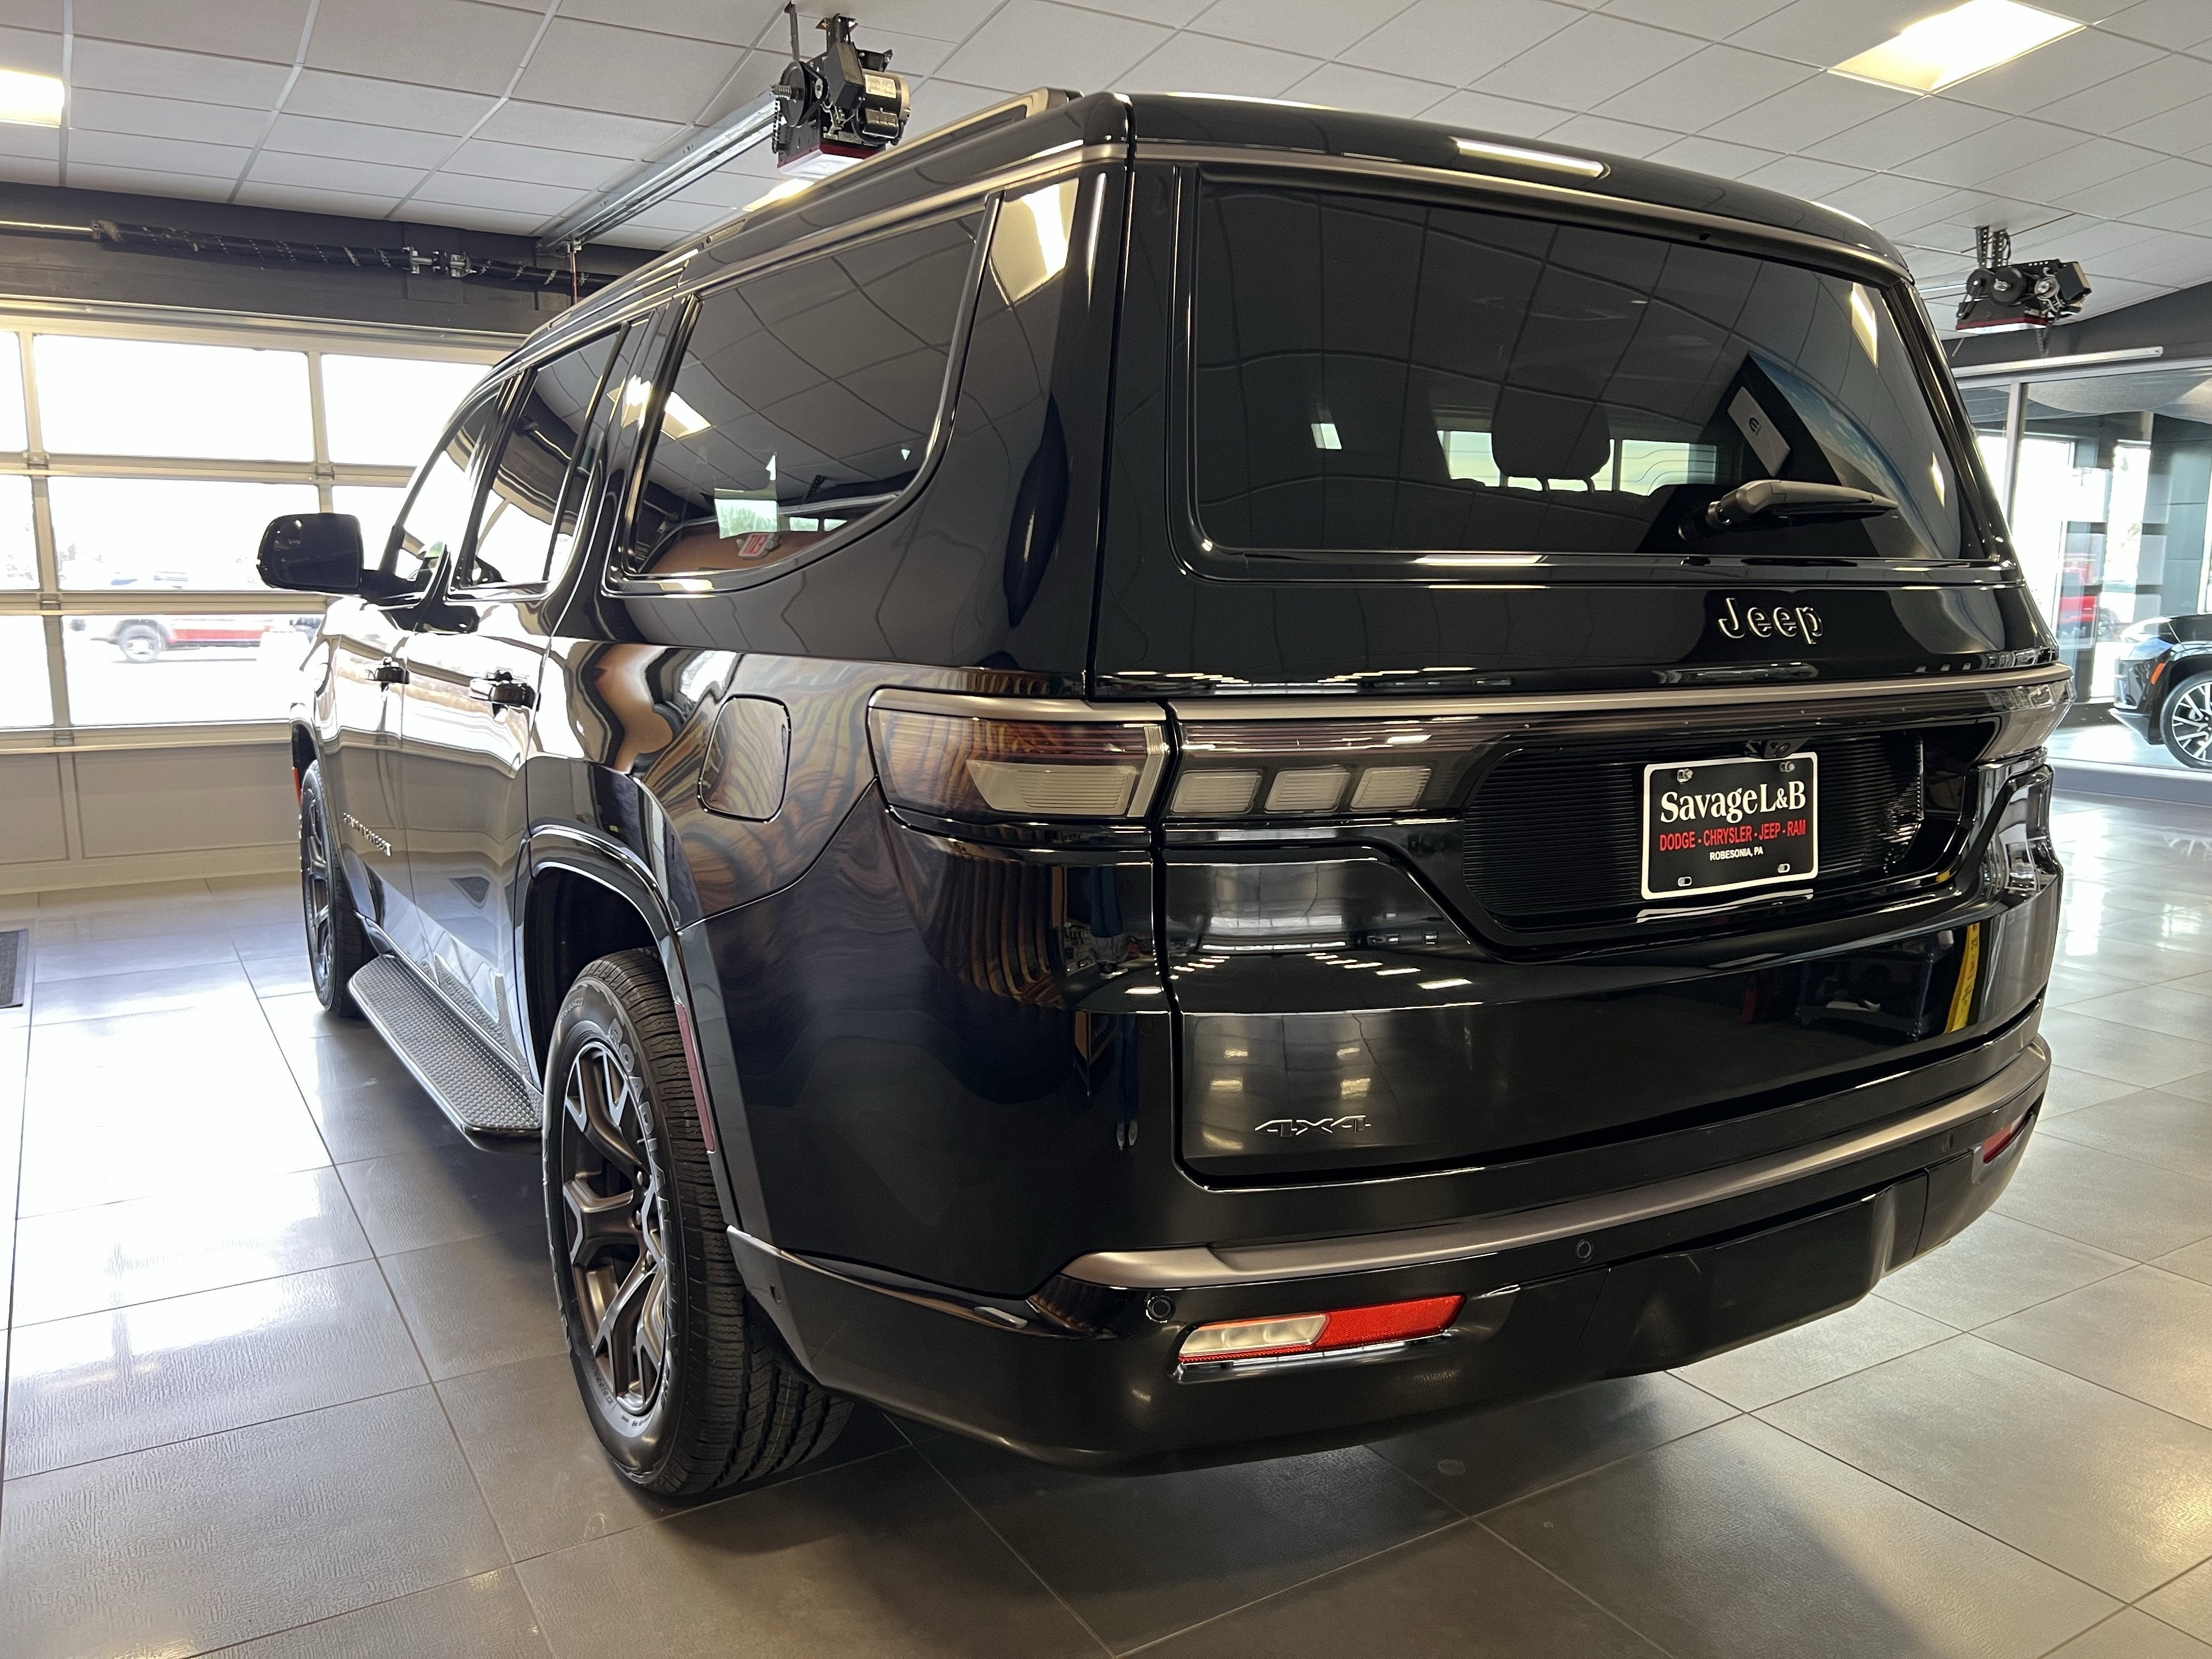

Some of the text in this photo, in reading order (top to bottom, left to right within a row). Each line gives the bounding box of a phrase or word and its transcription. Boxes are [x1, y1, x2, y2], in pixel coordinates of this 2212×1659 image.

[1717, 597, 1823, 644] Jeep
[1660, 820, 1806, 851] DODGE CHRYSLER JEEP RAM
[1709, 846, 1763, 861] ROBESONIA, PA
